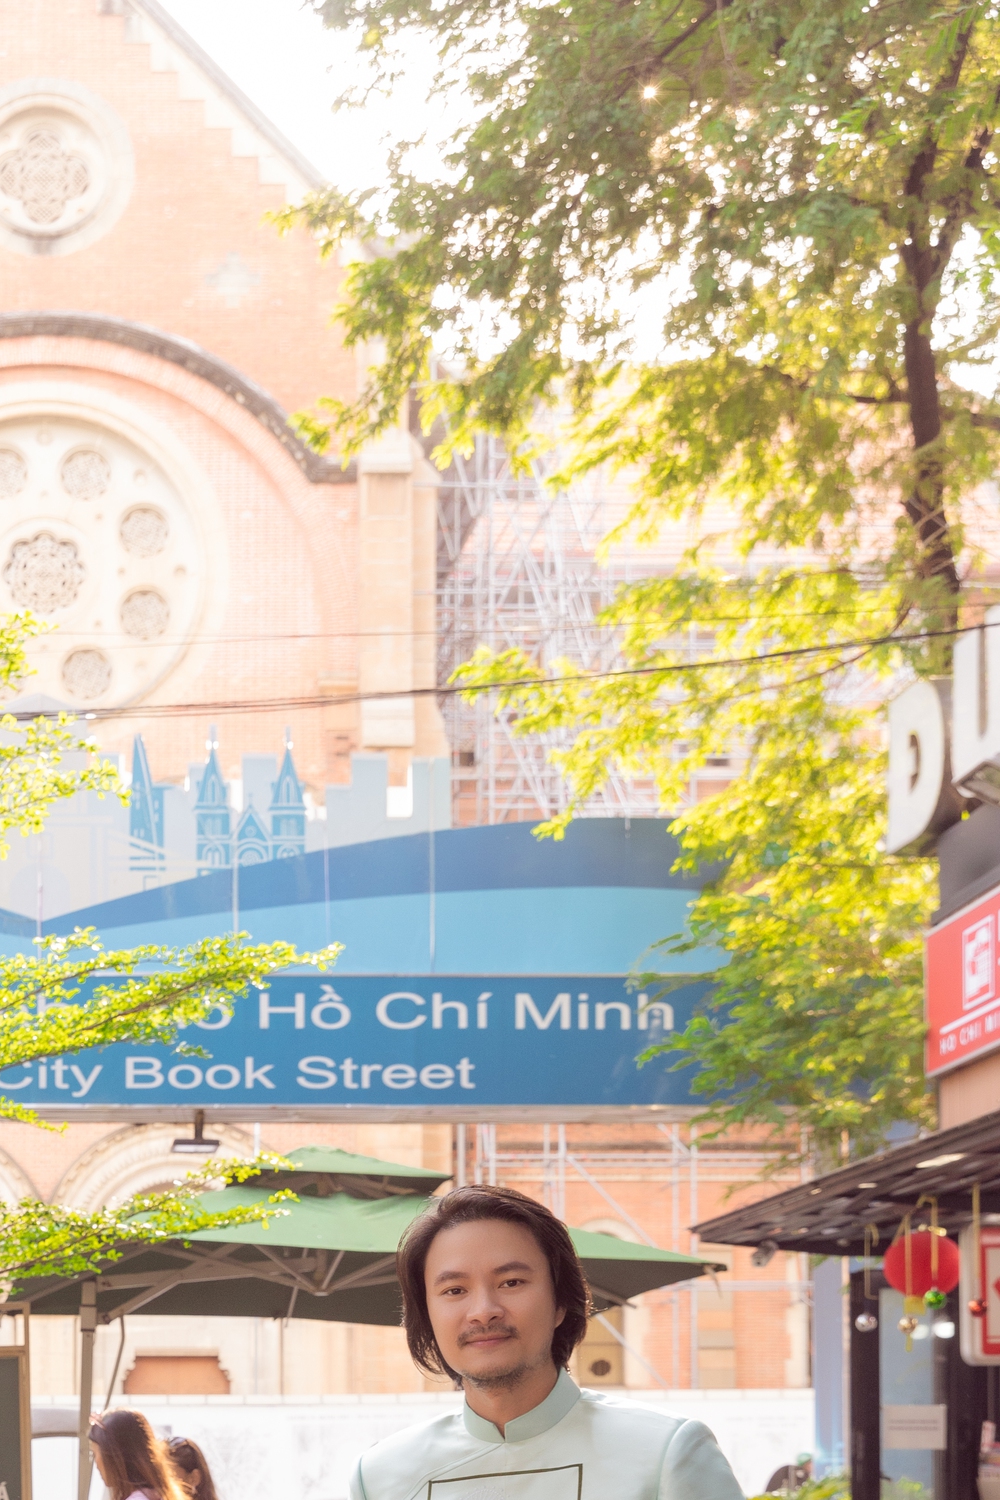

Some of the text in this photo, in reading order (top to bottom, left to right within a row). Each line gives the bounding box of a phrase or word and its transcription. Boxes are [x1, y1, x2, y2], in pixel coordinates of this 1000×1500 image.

[259, 984, 351, 1030] Hồ
[375, 991, 493, 1030] Chí
[514, 992, 675, 1031] Minh
[125, 1055, 276, 1090] Book
[296, 1055, 476, 1090] Street
